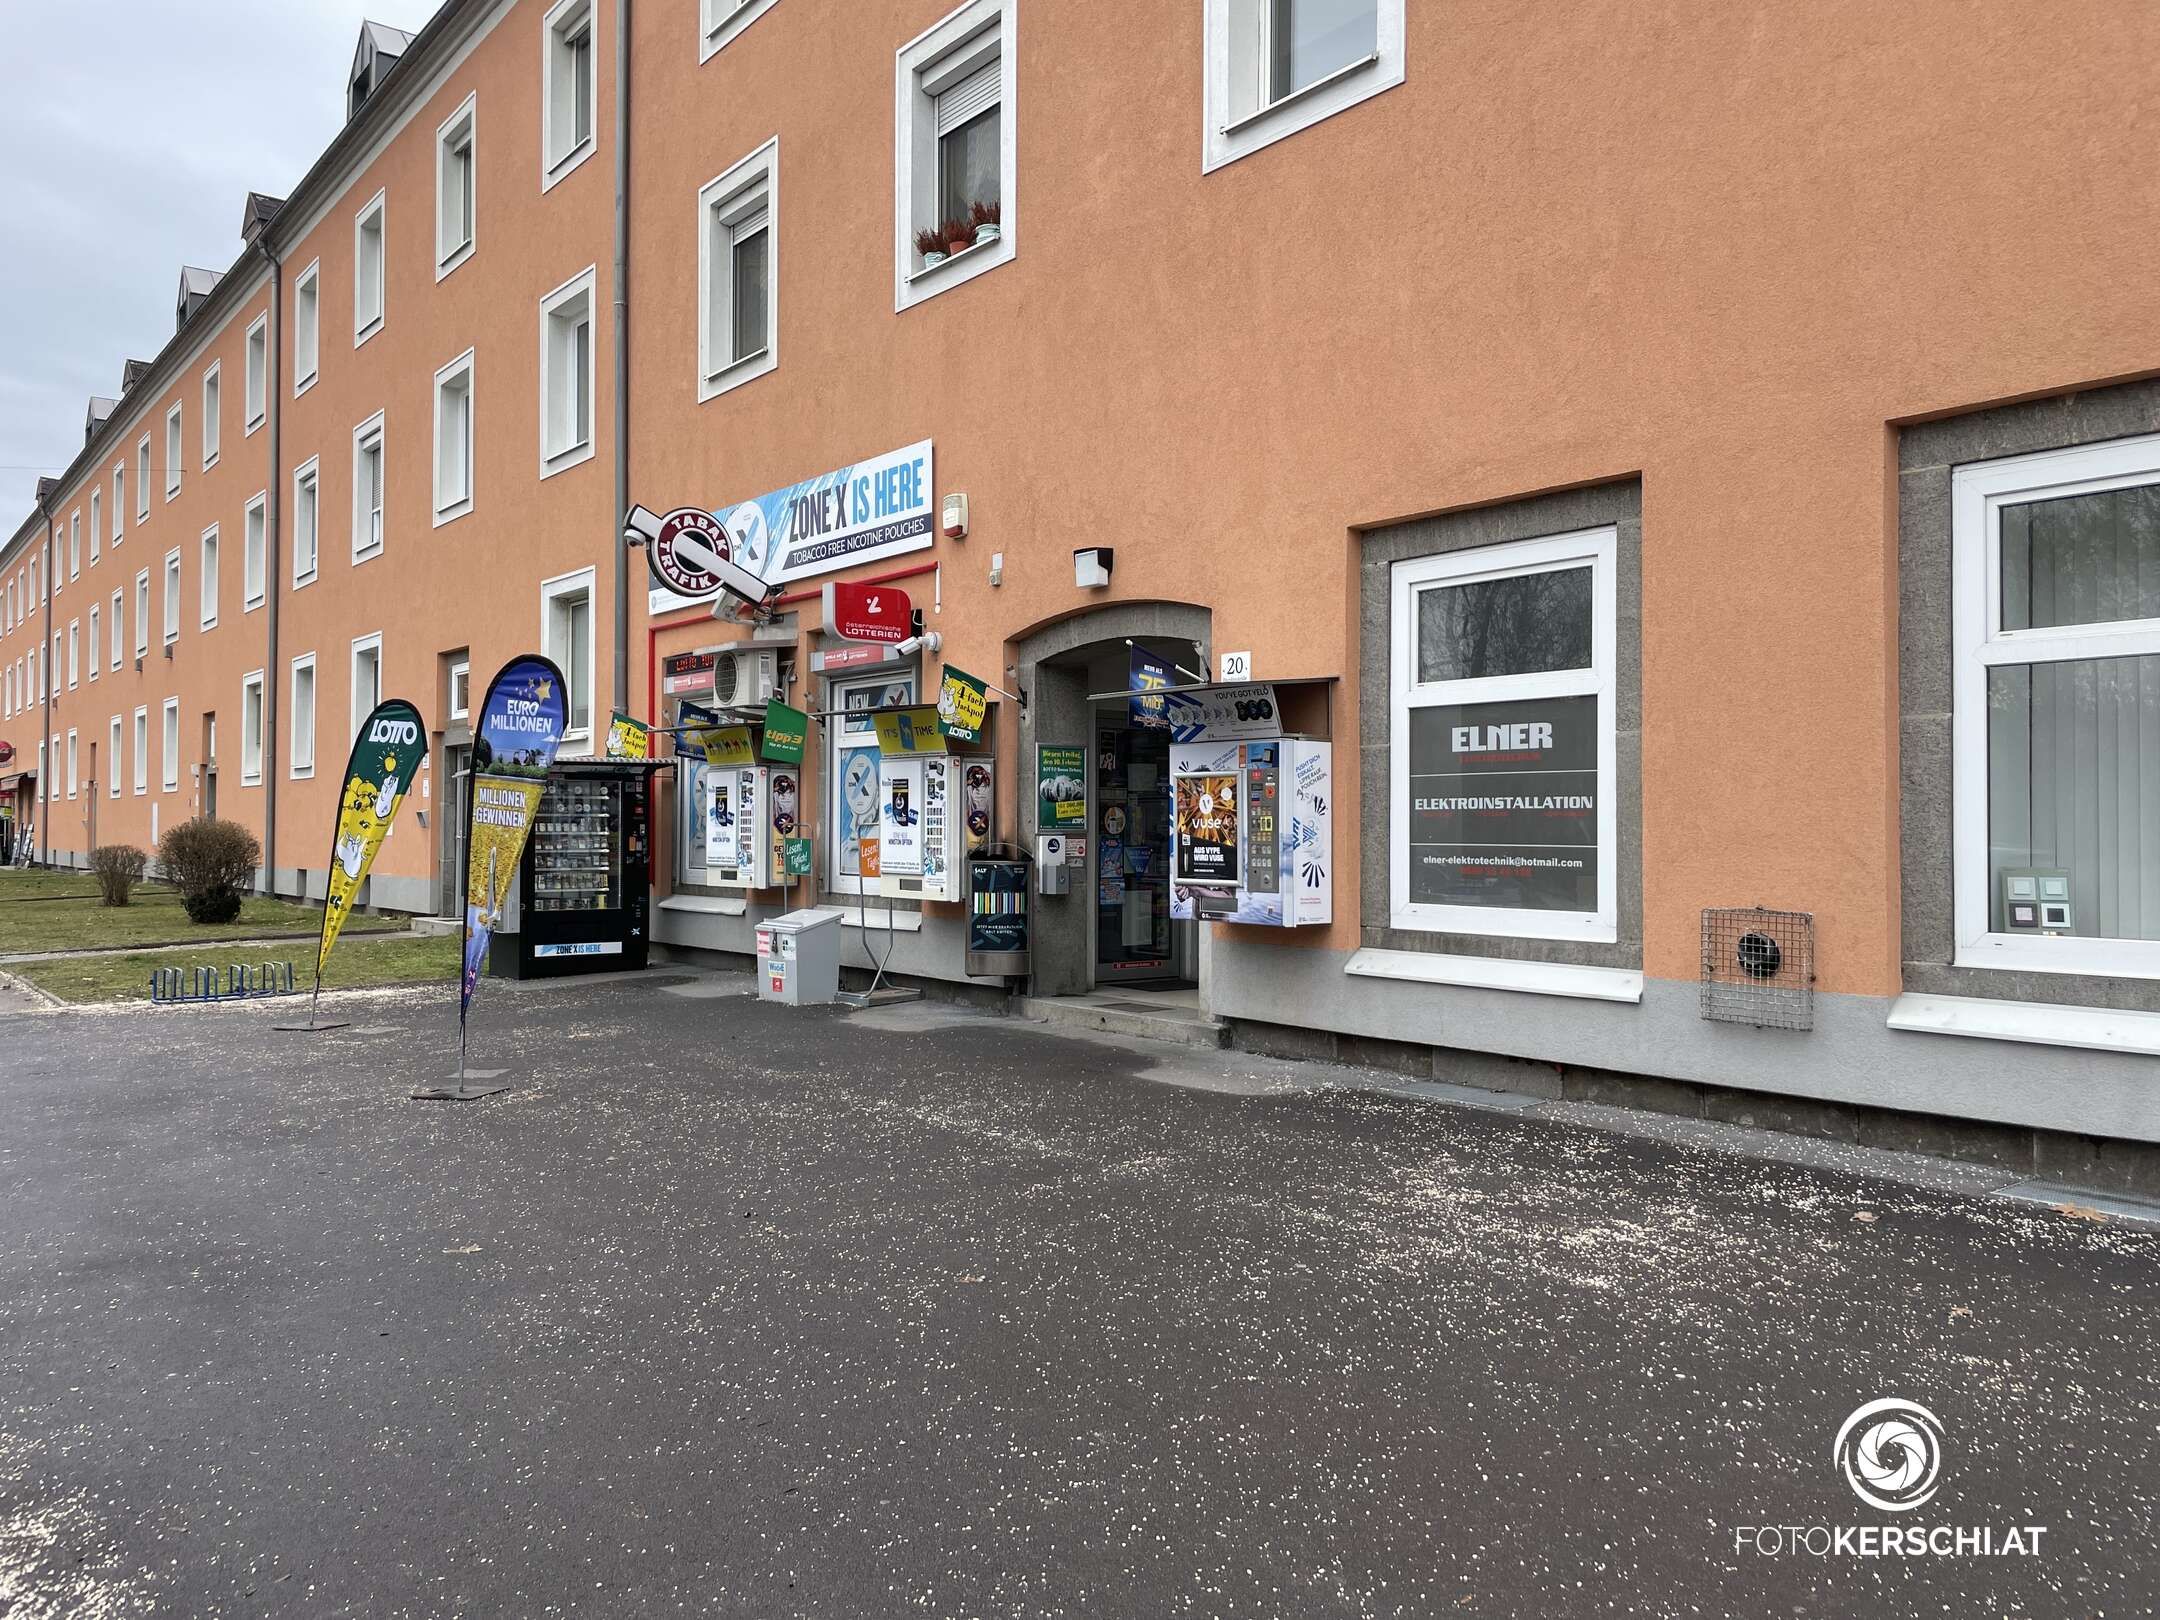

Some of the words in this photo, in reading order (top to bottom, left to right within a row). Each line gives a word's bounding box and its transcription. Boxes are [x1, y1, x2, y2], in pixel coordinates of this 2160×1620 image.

[789, 488, 831, 543] ZONE
[835, 483, 847, 530] X
[852, 476, 870, 525] IS
[874, 458, 924, 518] HERE
[671, 515, 728, 551] TABAK
[792, 545, 826, 565] TOBACCO
[828, 539, 846, 557] FREE
[847, 528, 884, 551] NICOTINE
[885, 518, 925, 539] POUCHES
[660, 541, 712, 588] TRAFIK
[846, 628, 901, 639] LOTTERIEN
[1227, 657, 1243, 674] 20
[1238, 690, 1251, 698] GOT
[507, 700, 540, 715] EURO
[955, 700, 984, 718] Jackpot
[368, 719, 417, 745] LOTTO
[491, 714, 552, 733] MILLIONEN
[914, 725, 935, 737] TIME
[948, 726, 972, 739] LOTTO
[1451, 722, 1553, 752] ELNER
[479, 788, 526, 807] MILLIONEN
[1415, 796, 1593, 810] ELEKTROINSTALLATION
[476, 809, 526, 828] GEWINNEN!
[1192, 818, 1222, 829] vuse
[861, 840, 879, 857] Lesen!
[1424, 855, 1583, 868] elner-elektrotechnik@hotmail.com
[556, 945, 573, 954] ZONE
[578, 945, 584, 953] IS
[586, 944, 601, 953] HERE
